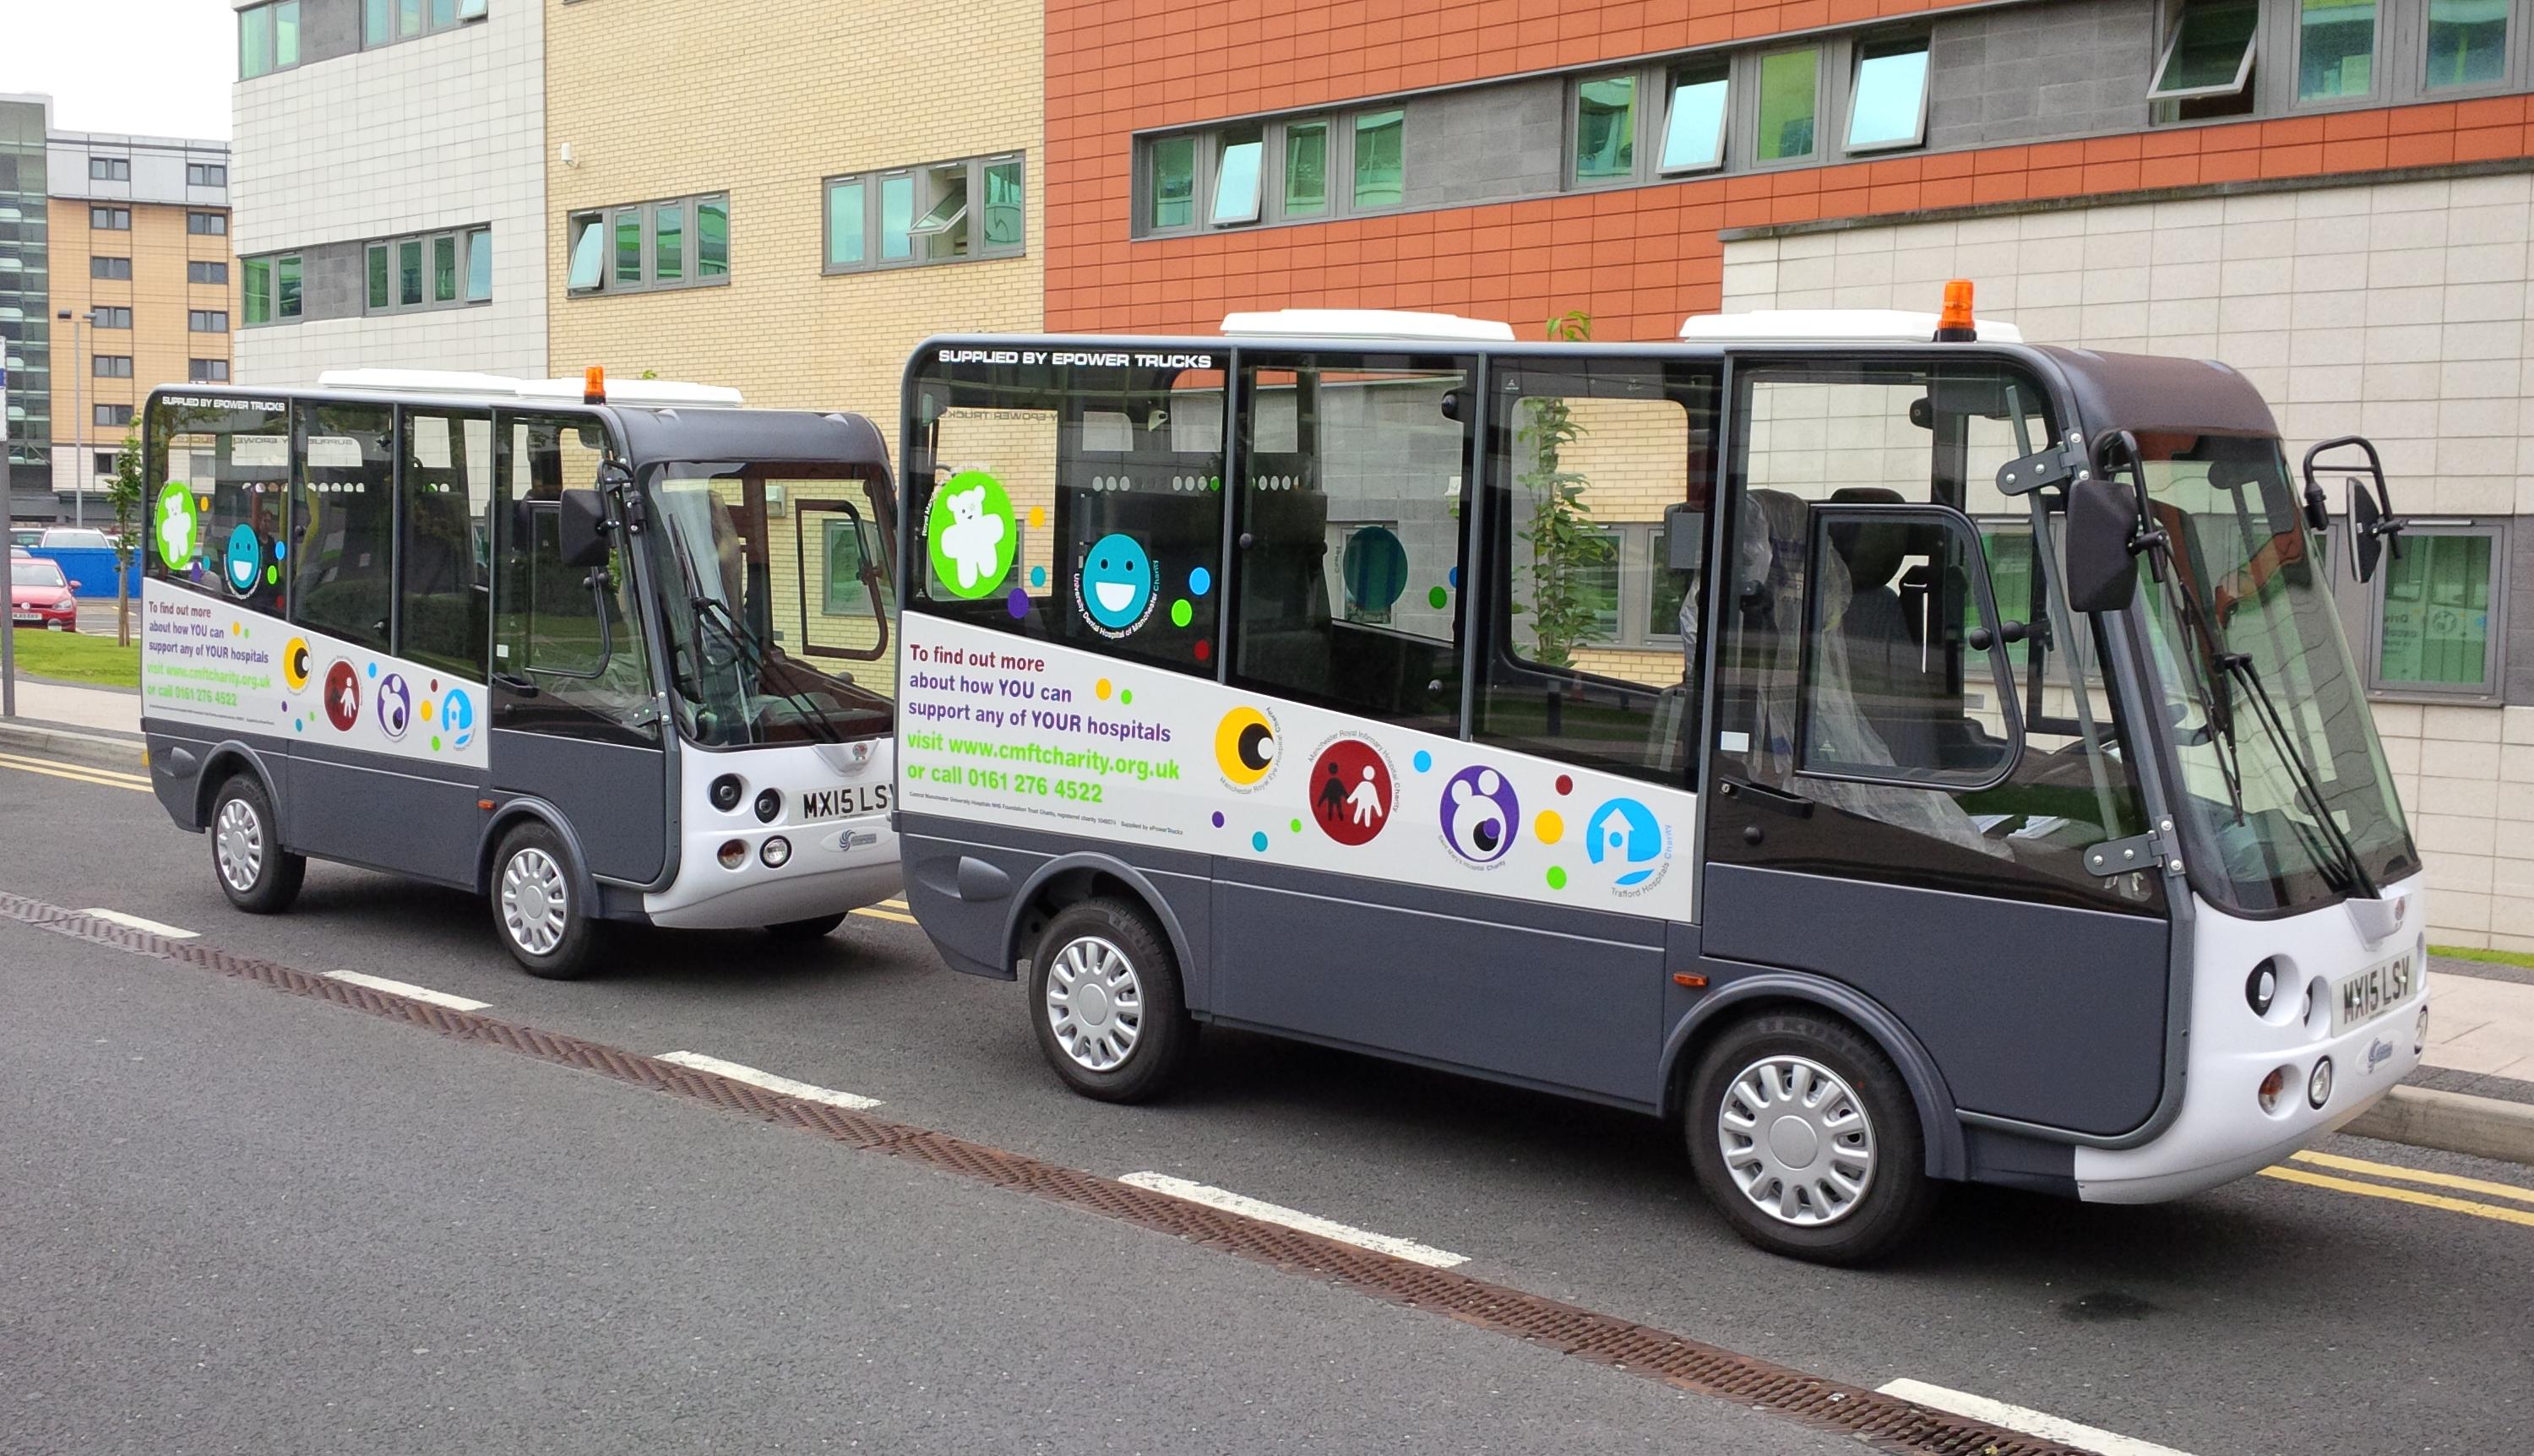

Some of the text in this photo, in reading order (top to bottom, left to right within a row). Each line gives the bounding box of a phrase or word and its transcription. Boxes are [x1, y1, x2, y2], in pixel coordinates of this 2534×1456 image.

[939, 350, 1211, 368] SUPPLIED BY EPOWER TRUCKS
[162, 396, 285, 411] SUPPLIED BY EPOWER TRUCKS
[149, 601, 211, 618] To find out more
[150, 620, 224, 638] about how YOU can
[149, 641, 269, 665] support any of YOUR hospitals
[910, 644, 1045, 672] To find out more
[910, 671, 1072, 703] about how YOU can
[908, 701, 1171, 742] support any of YOUR hospitals
[907, 730, 1180, 781] visit www.cmftcharity.org.uk
[907, 764, 1102, 803] or call 0161 276 4522
[803, 789, 854, 818] MX15
[1611, 823, 1673, 899] Trafford Hospitals Charity
[2344, 970, 2379, 1024] MX15
